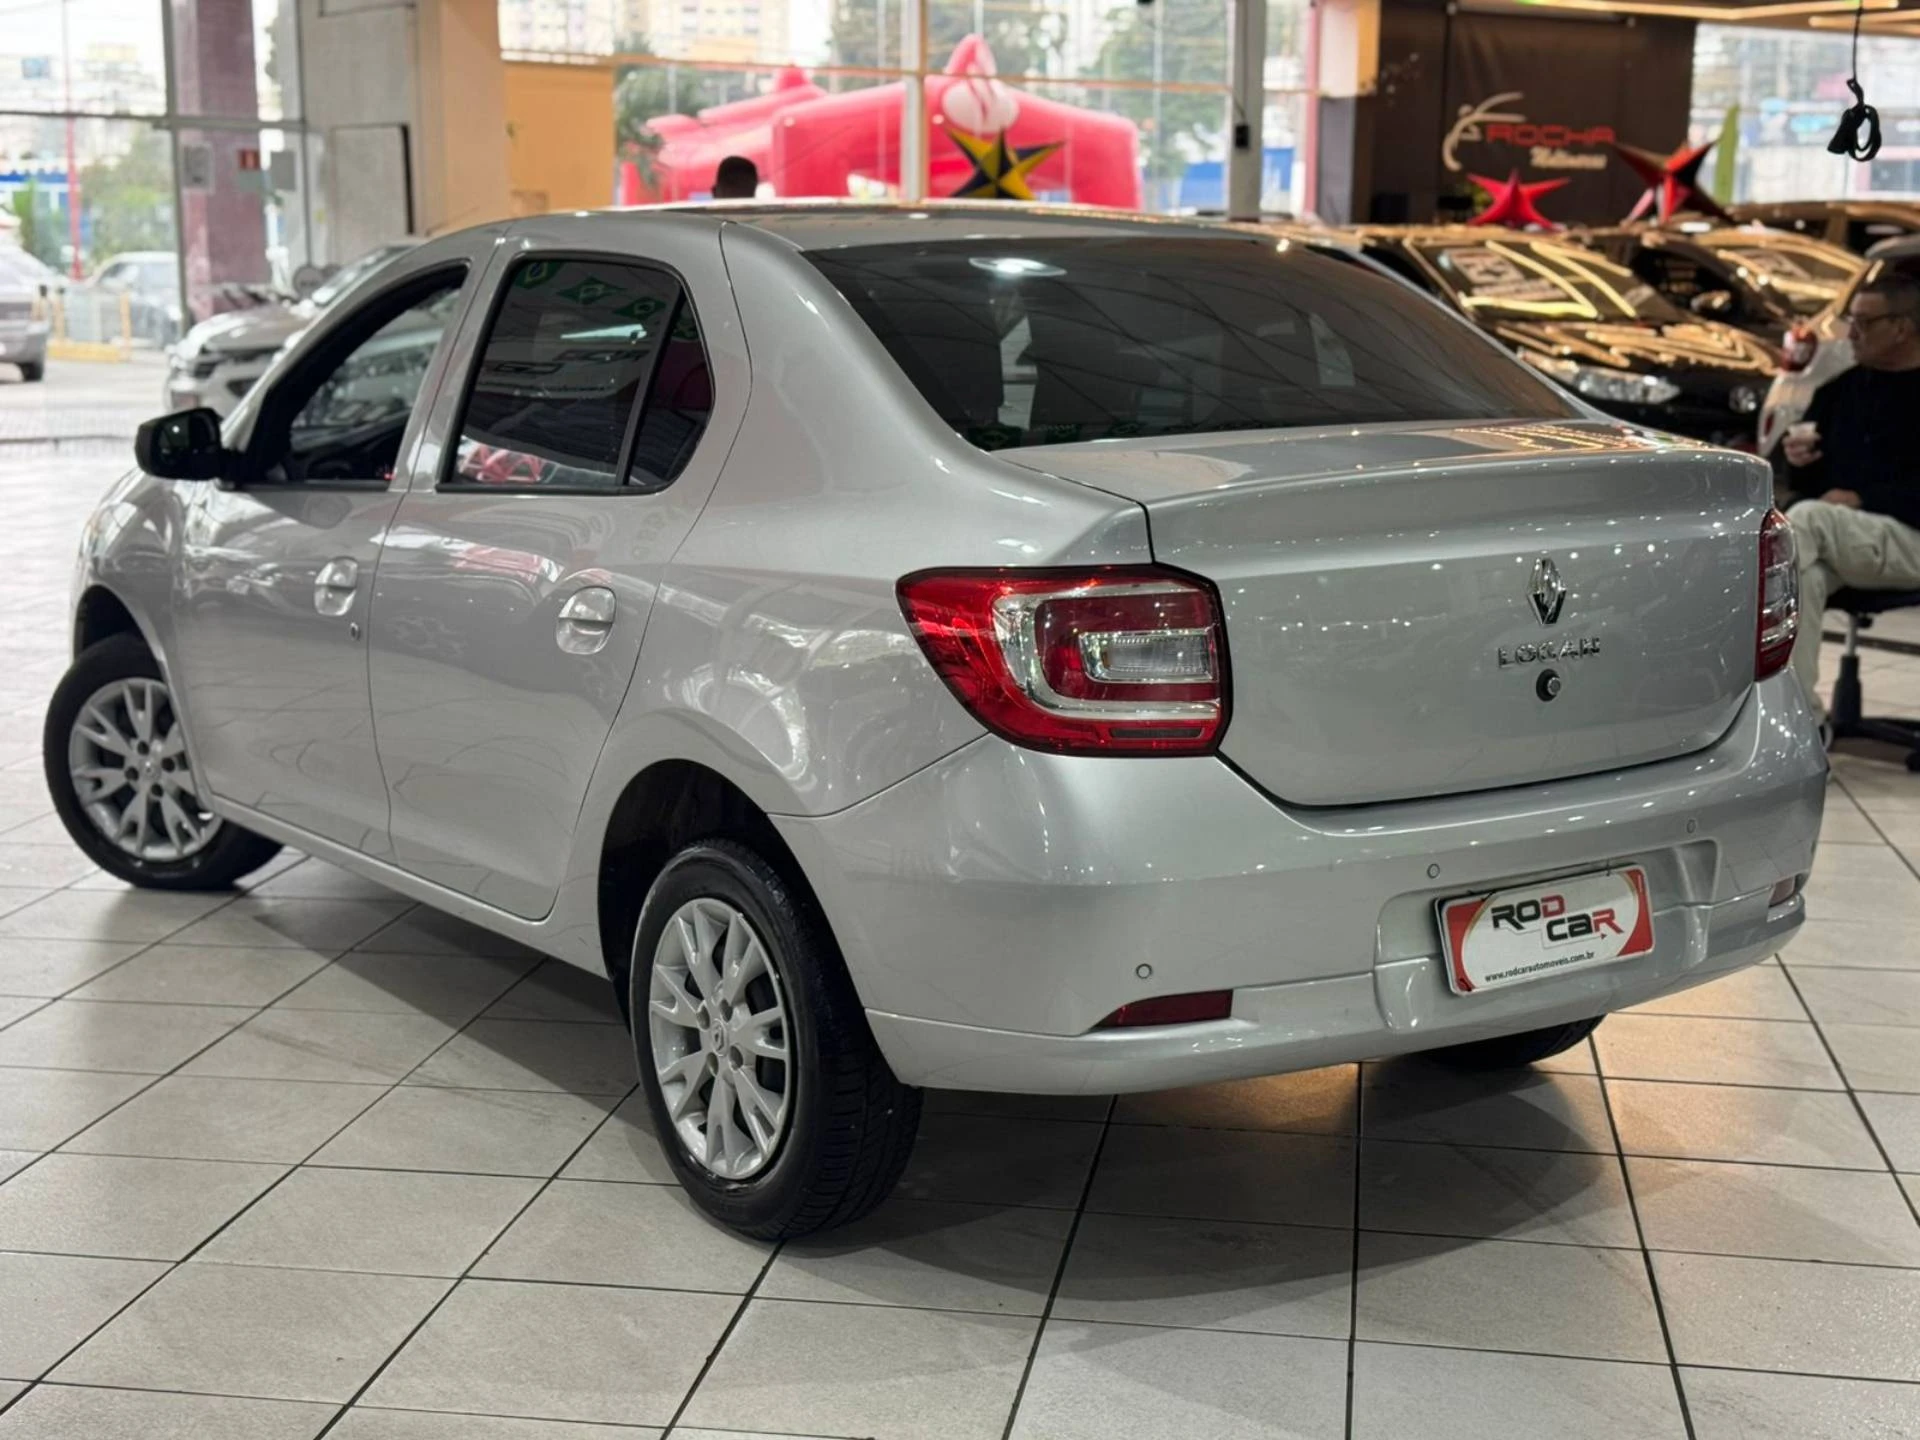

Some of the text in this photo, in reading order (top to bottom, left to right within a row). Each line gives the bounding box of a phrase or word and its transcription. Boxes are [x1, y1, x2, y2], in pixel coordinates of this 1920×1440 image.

[1486, 124, 1616, 147] ROCHA
[1491, 894, 1566, 930] ROD
[1484, 951, 1595, 982] www.rodcarautomoveis.com.br
